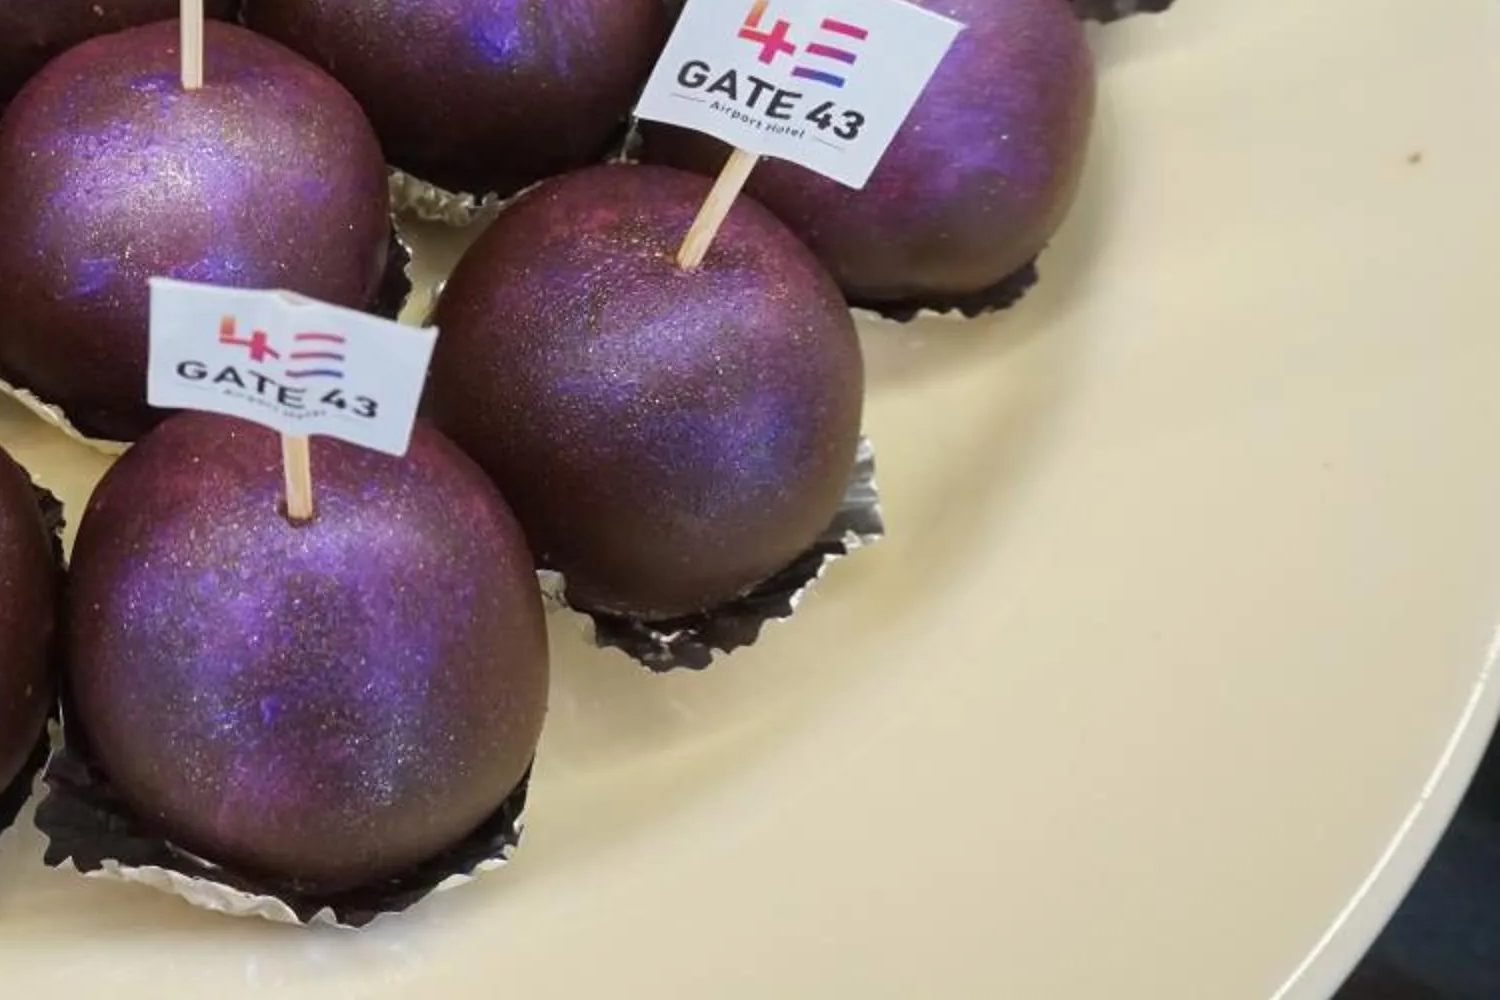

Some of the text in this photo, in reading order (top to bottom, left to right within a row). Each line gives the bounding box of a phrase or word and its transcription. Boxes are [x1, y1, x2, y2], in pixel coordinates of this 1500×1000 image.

[676, 60, 865, 141] GATE 43
[710, 98, 763, 130] Airport
[176, 360, 378, 418] GATE 43
